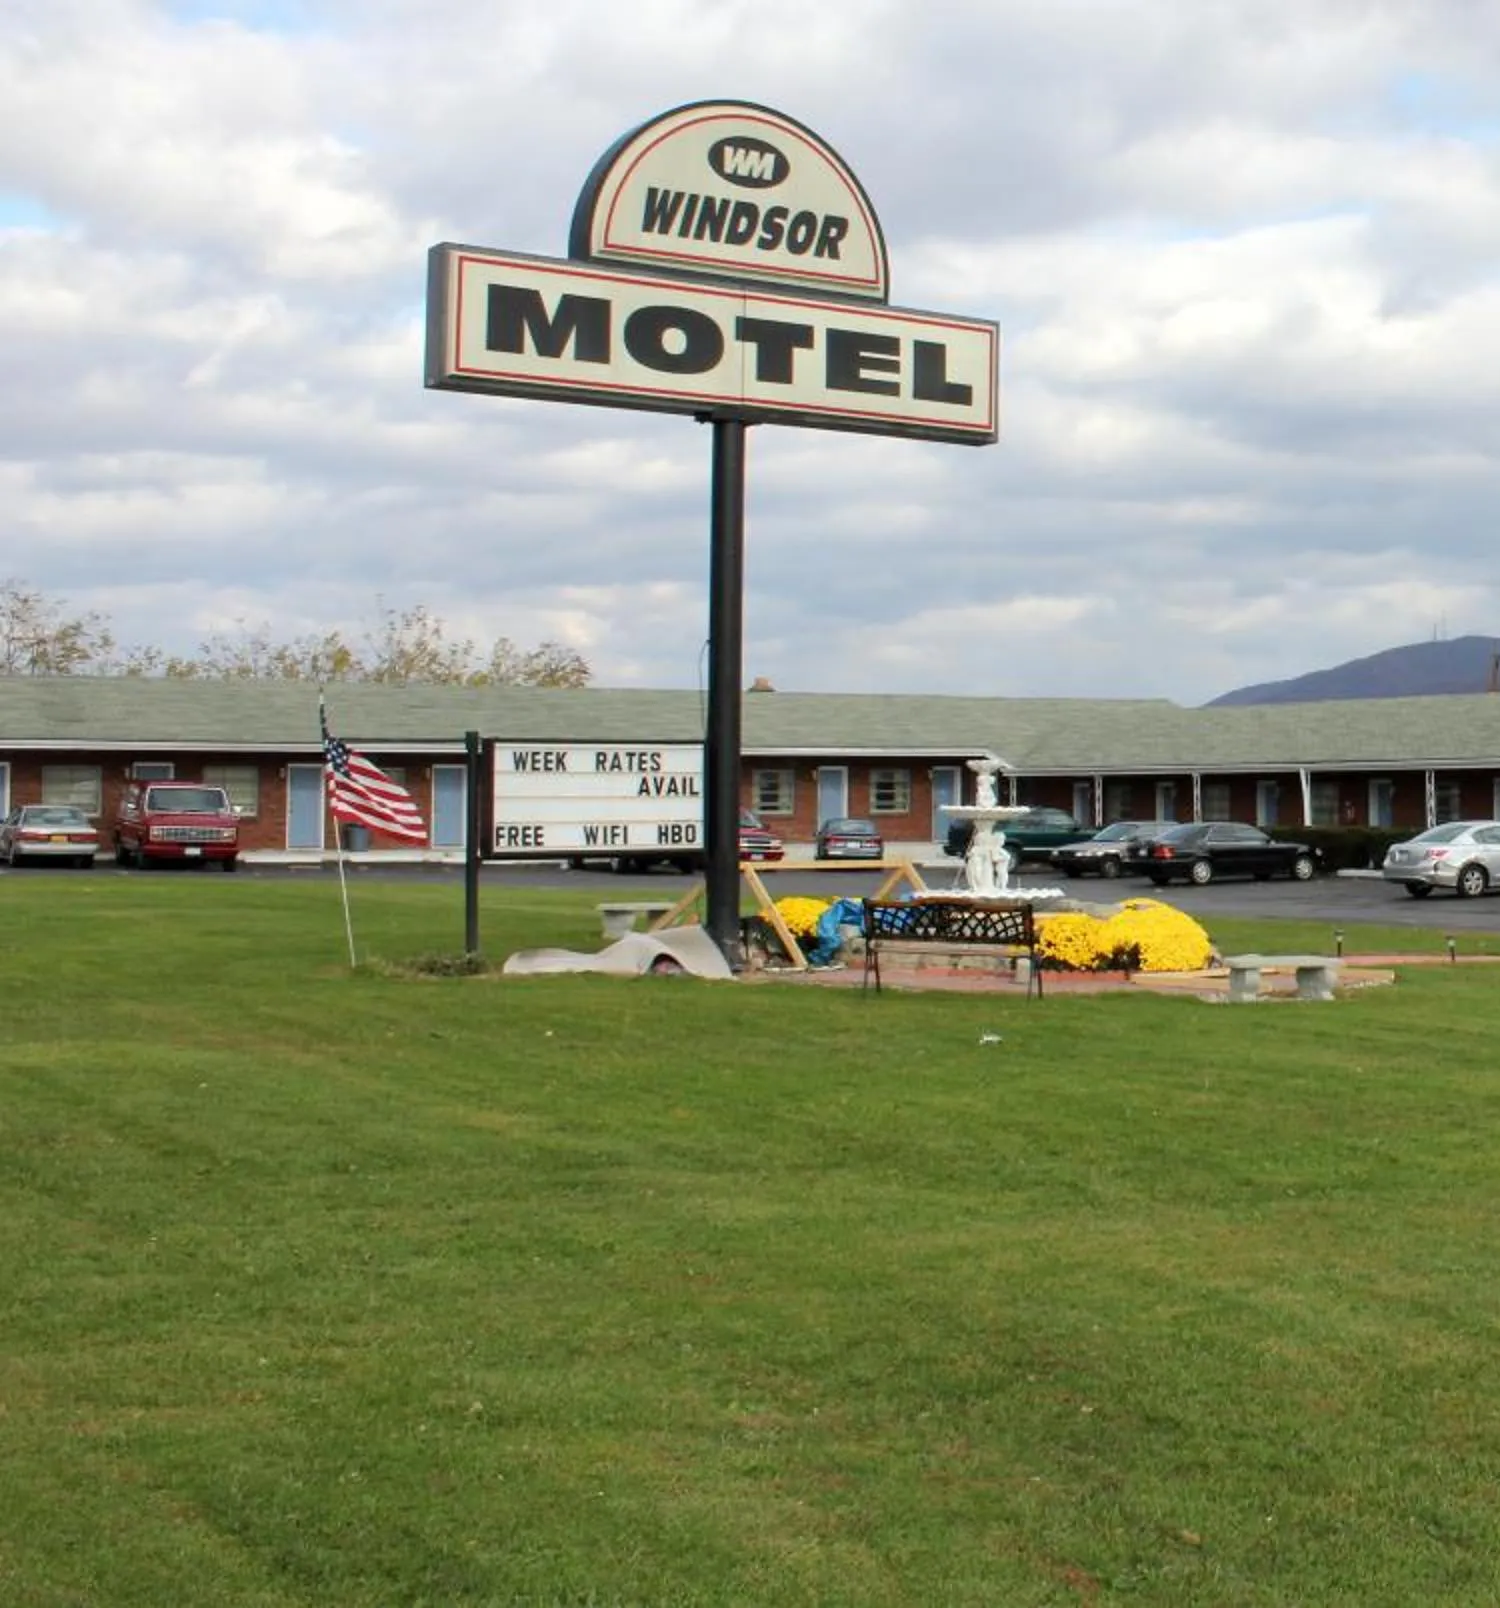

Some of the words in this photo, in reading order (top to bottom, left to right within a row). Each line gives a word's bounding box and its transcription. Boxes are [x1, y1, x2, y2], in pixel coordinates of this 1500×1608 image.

[722, 146, 776, 180] WM
[641, 187, 849, 260] WINDSOR
[486, 283, 974, 407] MOTEL
[513, 752, 567, 772] WEEK
[595, 752, 662, 772] RATES
[637, 776, 700, 797] AVAIL
[496, 825, 544, 848] FREE
[583, 825, 628, 846] WIFI
[657, 823, 697, 845] HBO
